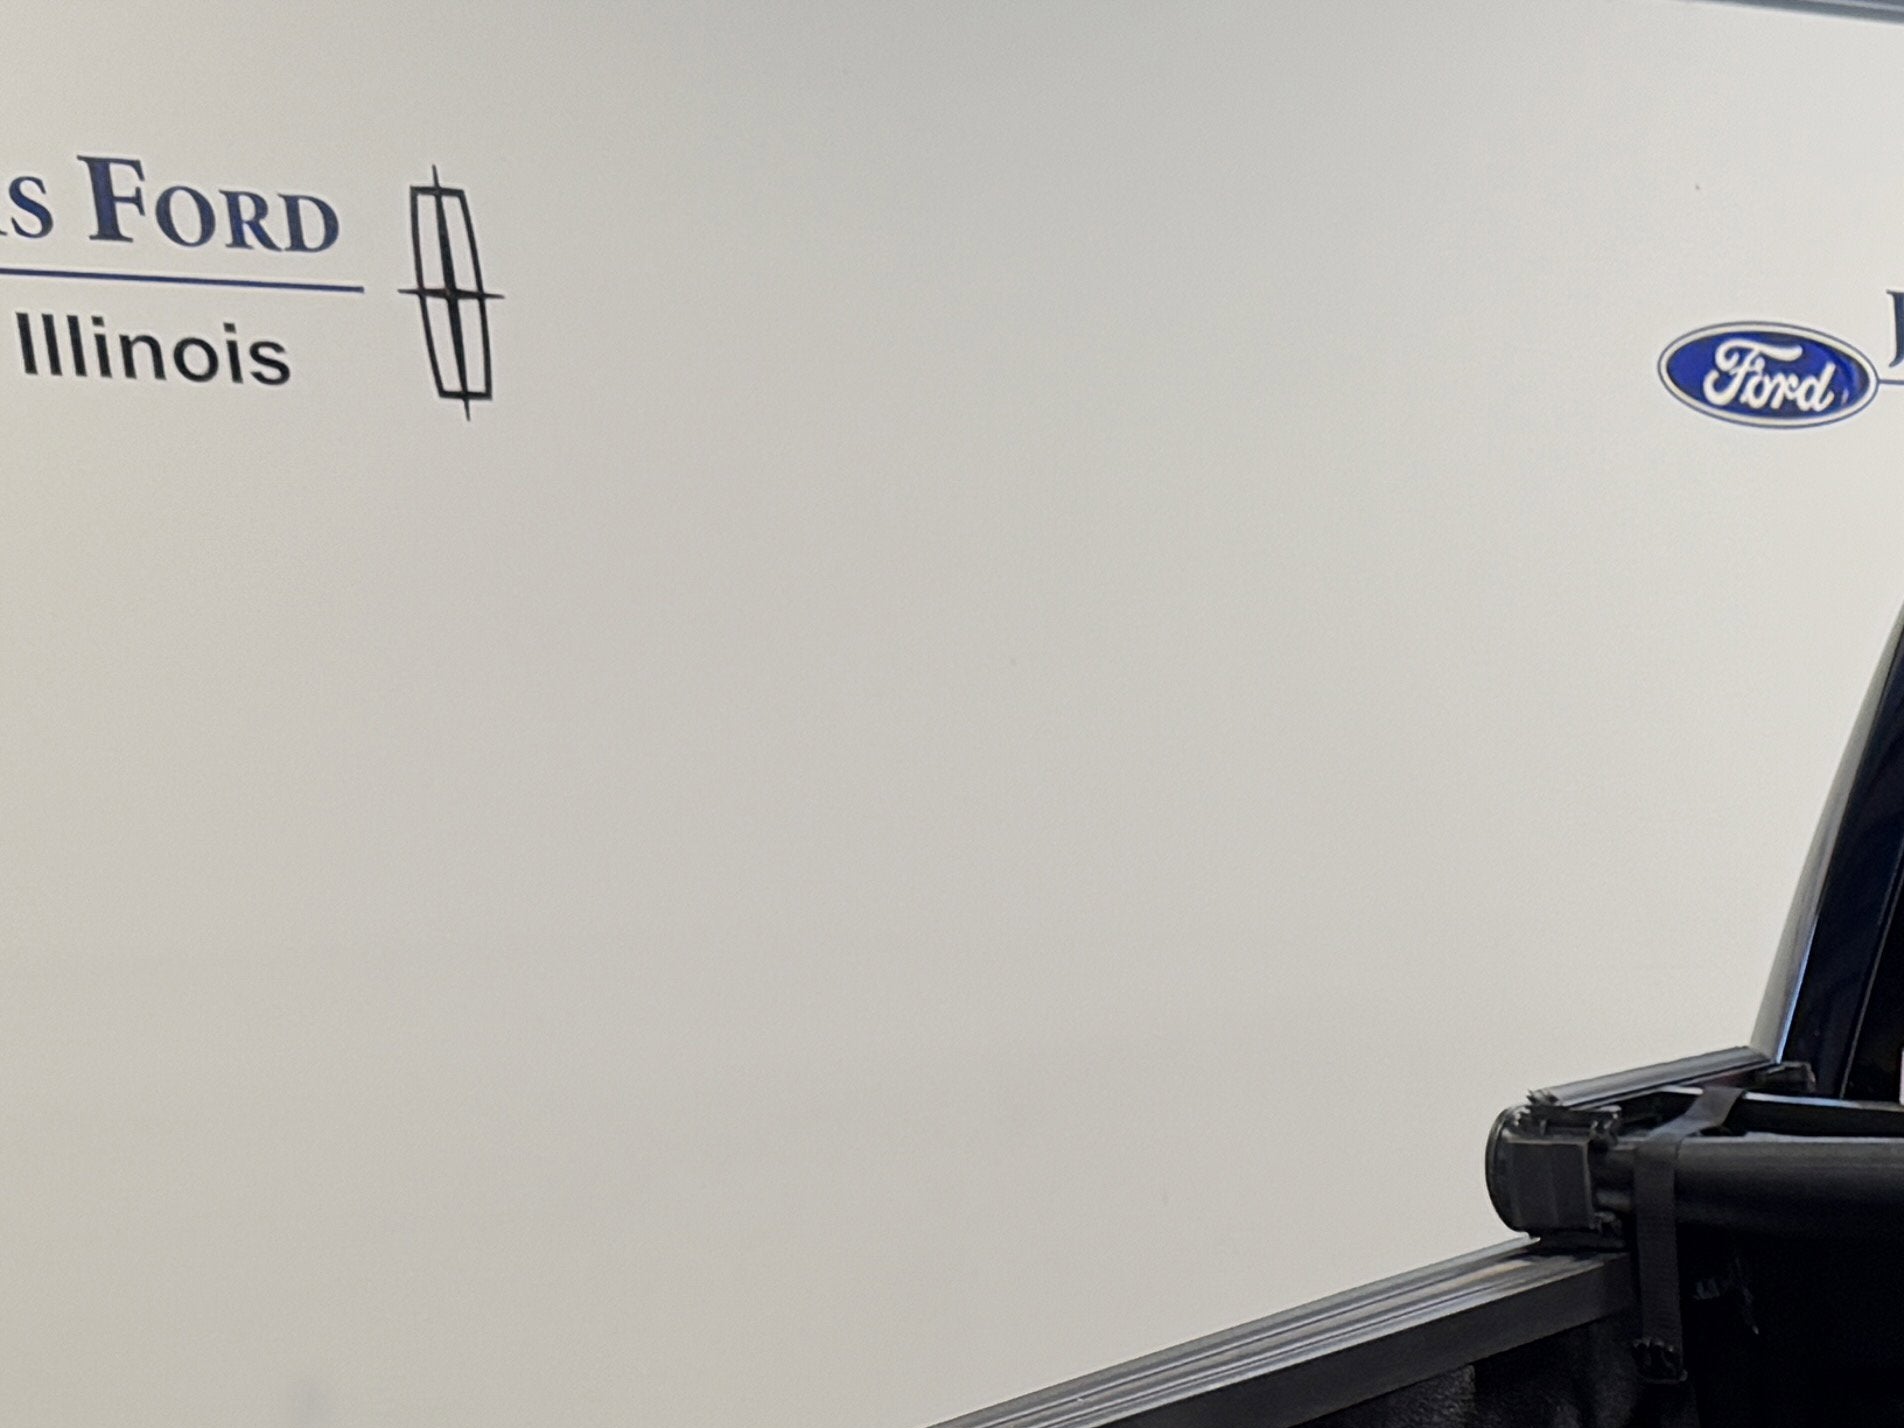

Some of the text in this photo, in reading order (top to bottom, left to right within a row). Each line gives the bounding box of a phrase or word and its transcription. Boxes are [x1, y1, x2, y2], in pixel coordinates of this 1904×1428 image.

[76, 154, 340, 253] FORD
[15, 311, 291, 387] Illinois
[1703, 338, 1836, 412] Ford
